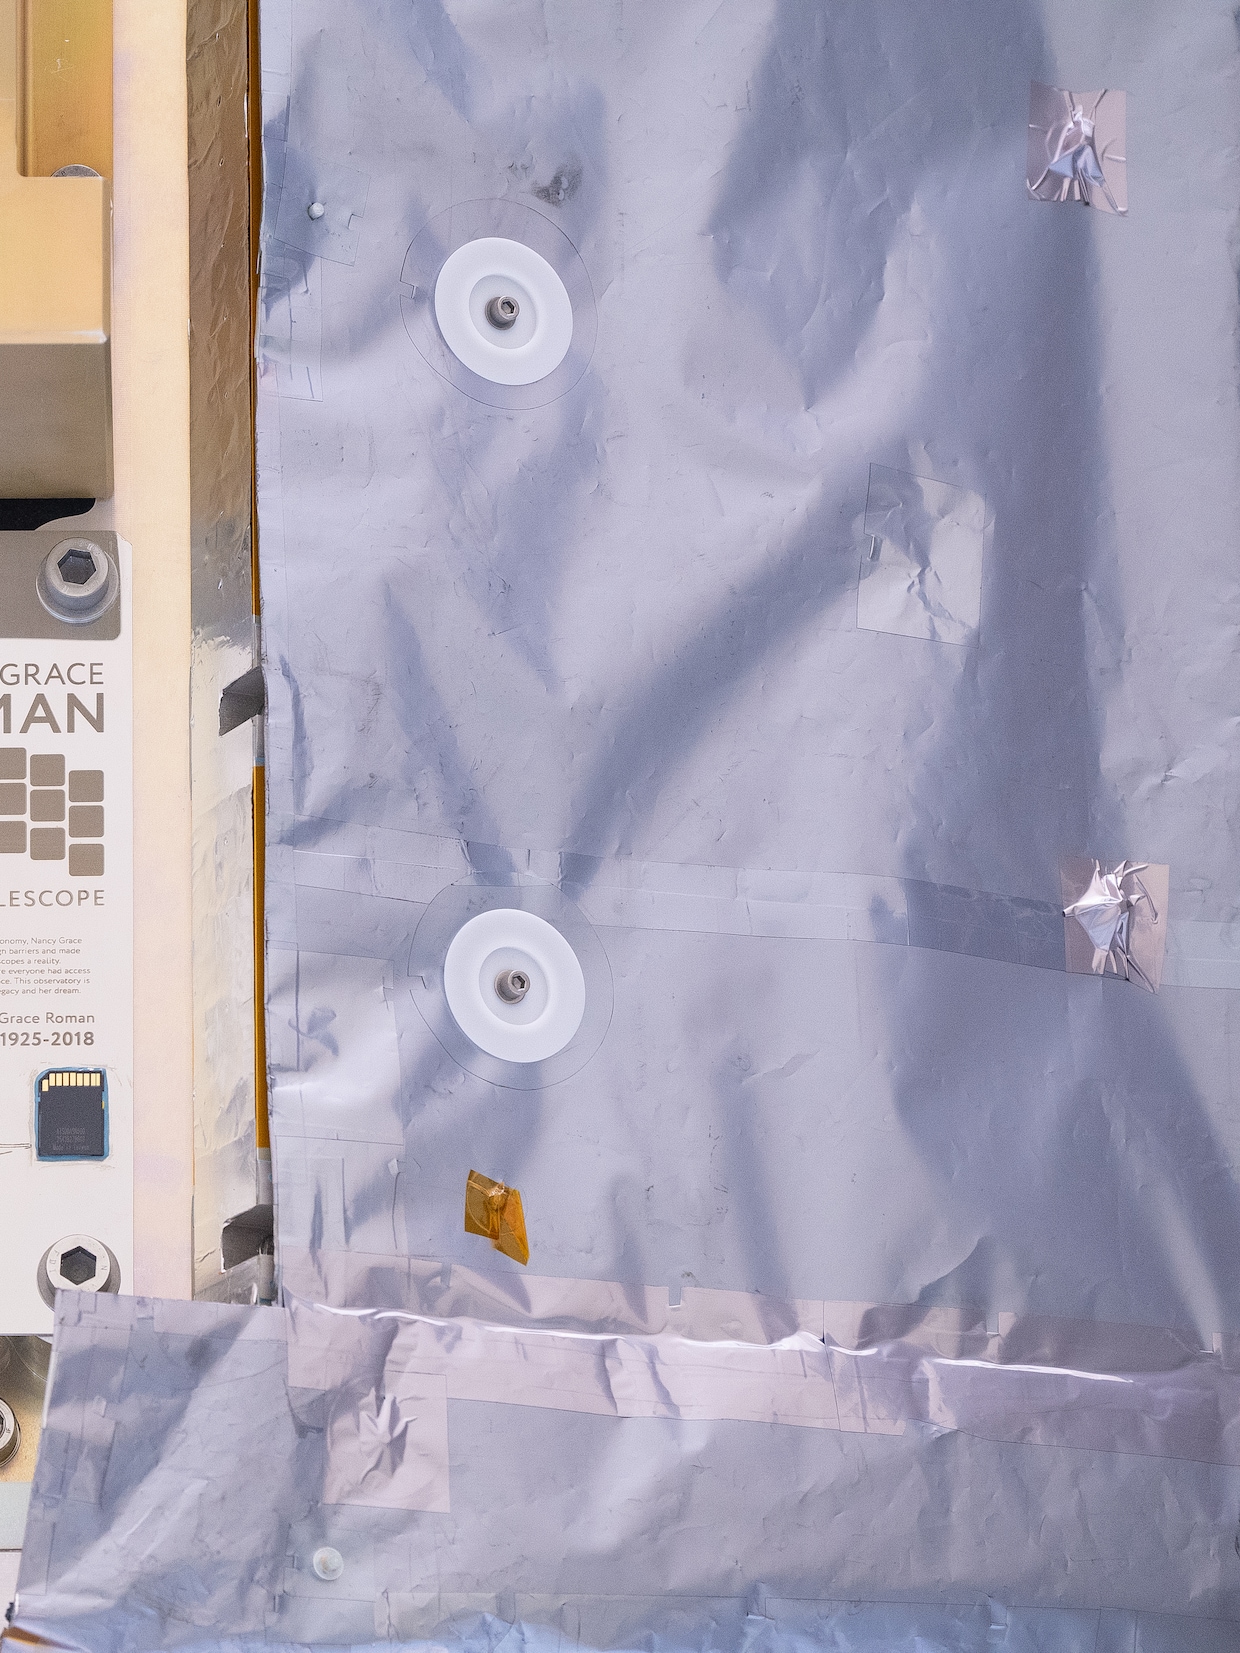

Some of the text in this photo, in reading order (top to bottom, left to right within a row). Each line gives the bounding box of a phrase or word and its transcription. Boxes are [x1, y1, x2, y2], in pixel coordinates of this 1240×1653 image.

[0, 662, 104, 686] GRACE
[30, 937, 57, 946] Nancy
[58, 936, 83, 945] Grace
[9, 947, 40, 955] barriers
[41, 947, 57, 955] and
[58, 947, 81, 955] made
[33, 957, 61, 966] reality.
[47, 967, 62, 975] had
[13, 977, 32, 985] This
[33, 978, 82, 986] observatory
[21, 987, 37, 995] and
[45, 1011, 95, 1024] Roman
[0, 1031, 95, 1047] 1925-2018
